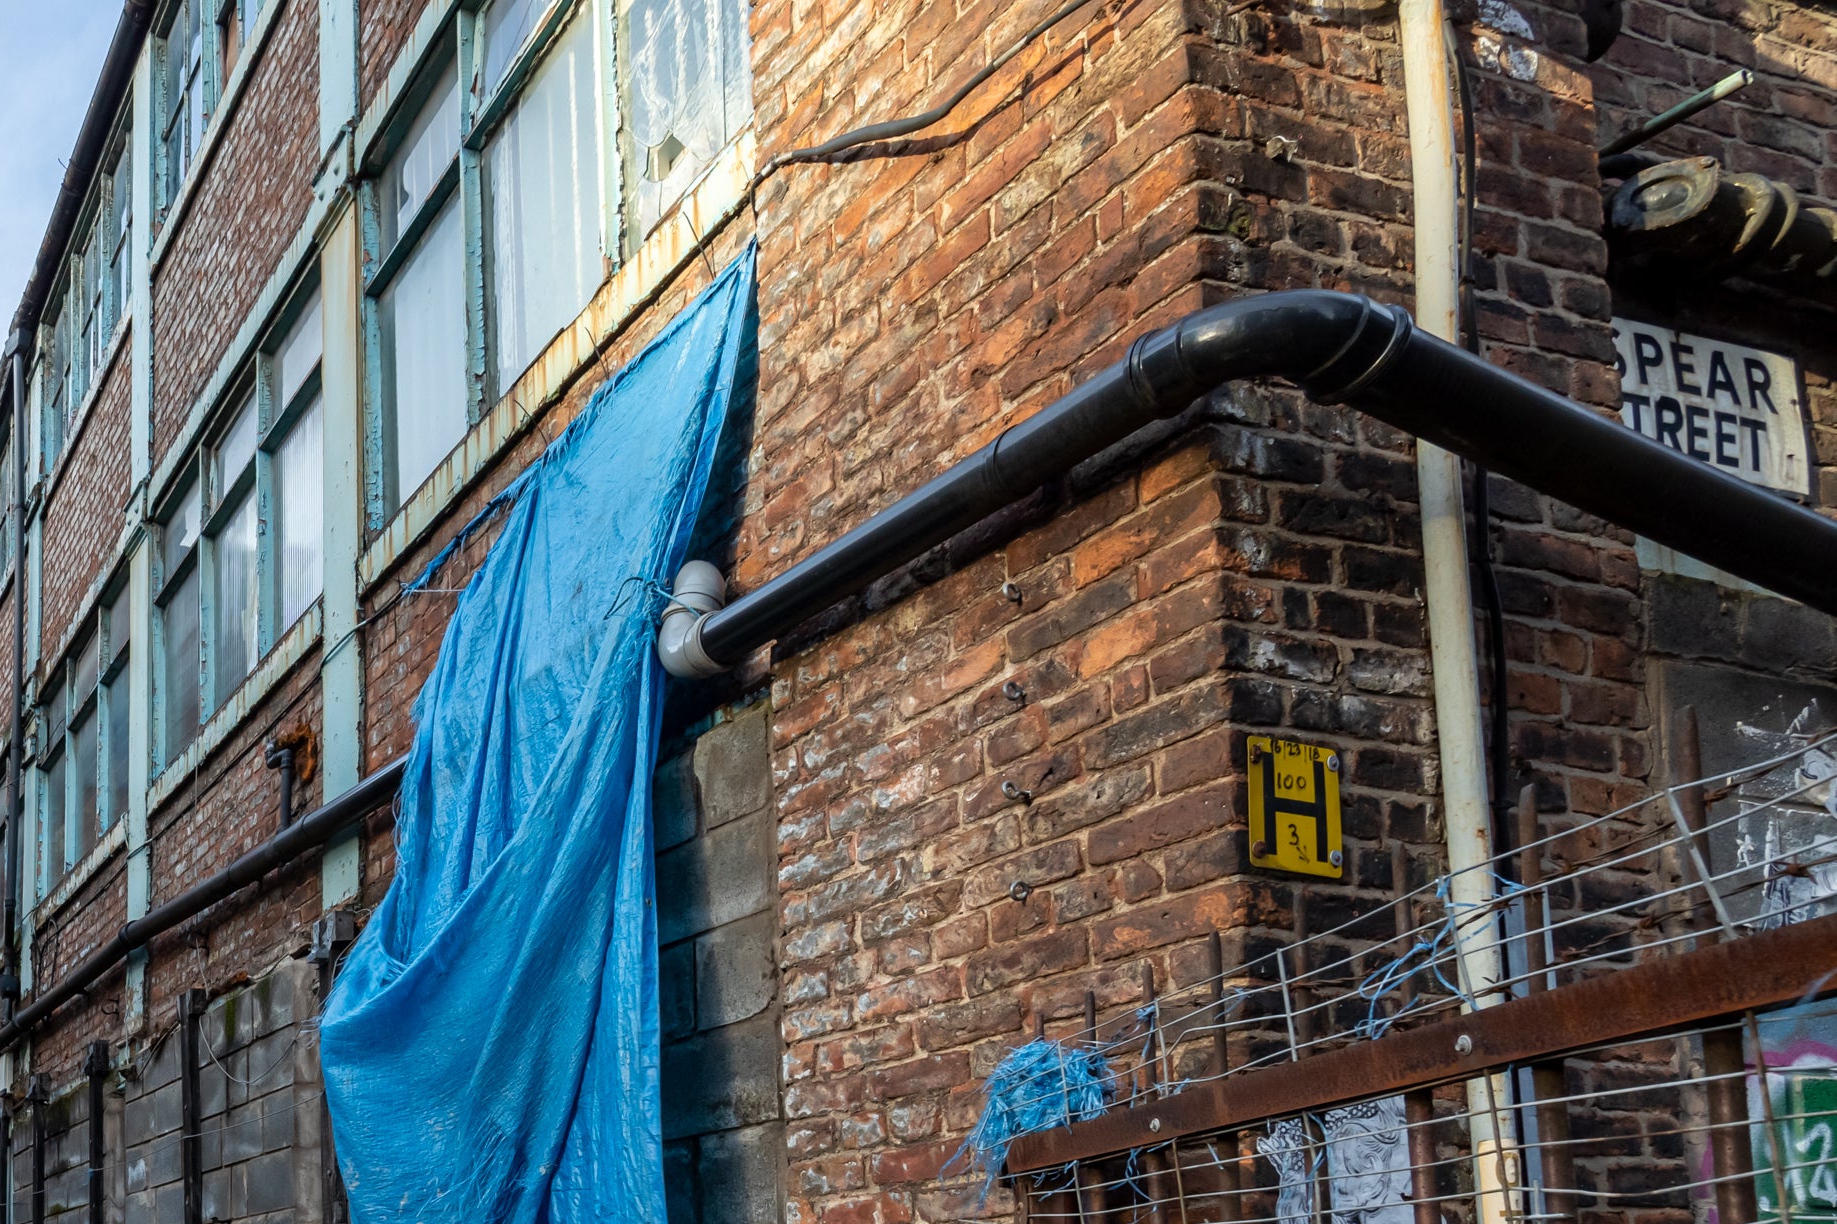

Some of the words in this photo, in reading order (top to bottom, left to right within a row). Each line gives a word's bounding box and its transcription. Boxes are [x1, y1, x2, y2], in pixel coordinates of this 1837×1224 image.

[1622, 392, 1767, 472] TREET
[1262, 751, 1328, 863] H
[1277, 773, 1306, 790] 100
[1288, 823, 1299, 845] 3
